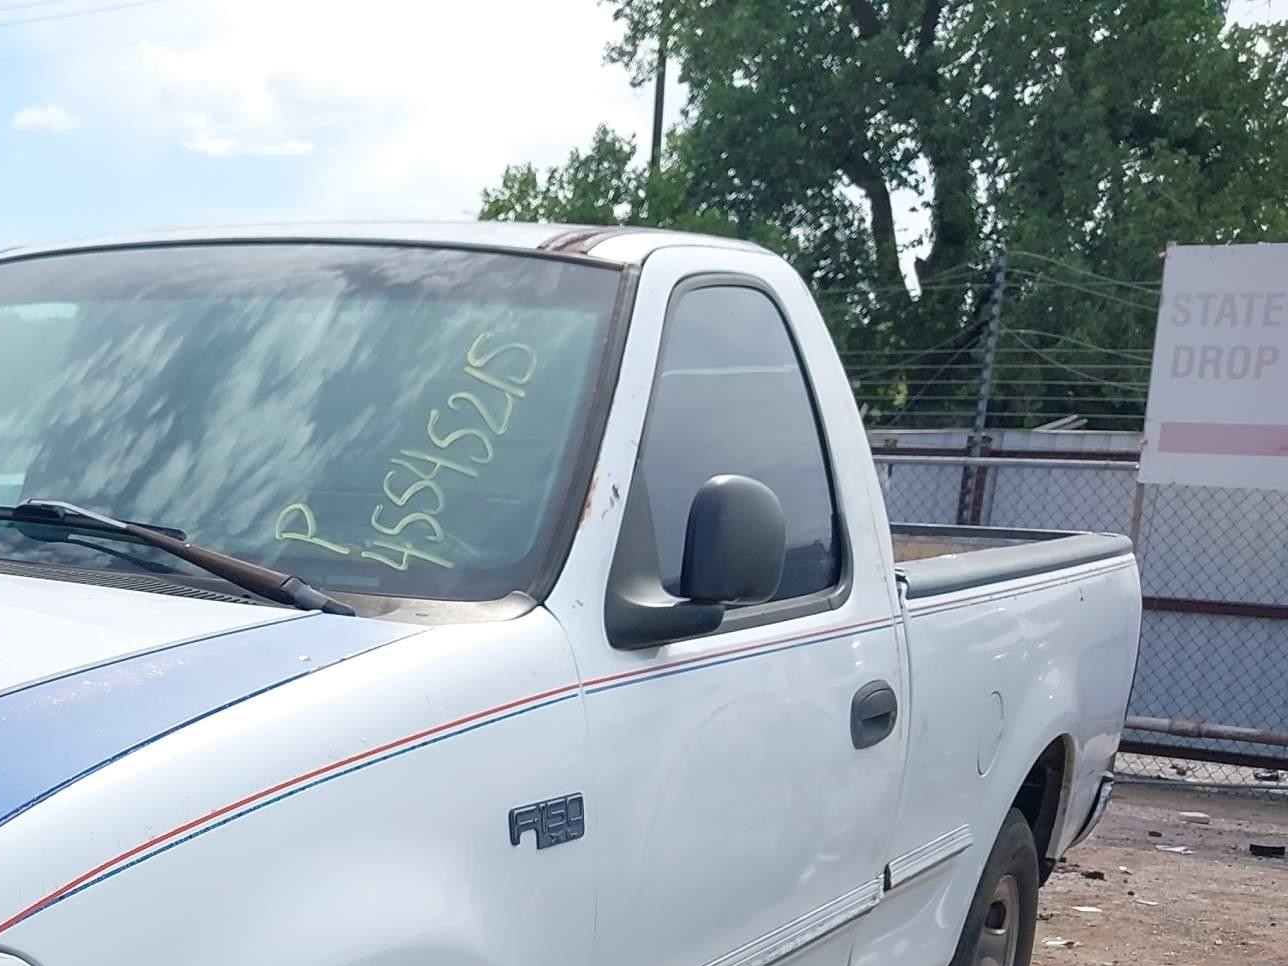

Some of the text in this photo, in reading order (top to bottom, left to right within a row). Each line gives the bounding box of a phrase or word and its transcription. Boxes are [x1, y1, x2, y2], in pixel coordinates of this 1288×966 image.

[1170, 292, 1286, 328] STATE
[1170, 344, 1280, 380] DROP
[361, 332, 538, 571] 45545215
[275, 502, 350, 554] P
